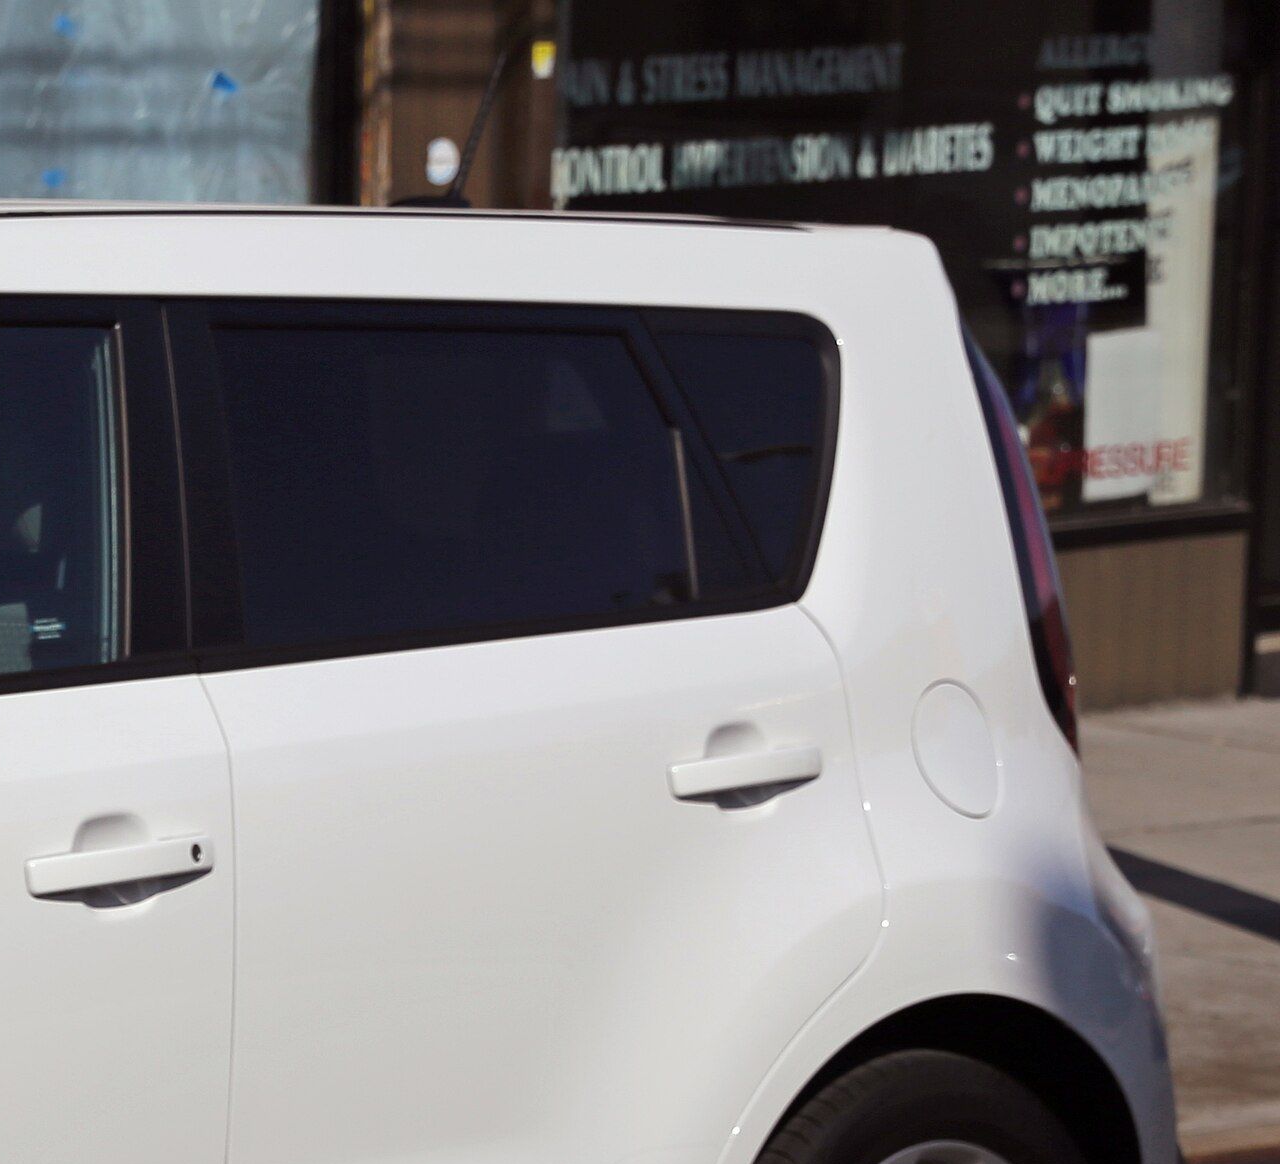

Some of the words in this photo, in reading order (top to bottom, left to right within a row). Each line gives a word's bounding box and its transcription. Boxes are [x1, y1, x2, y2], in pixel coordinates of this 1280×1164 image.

[561, 57, 611, 106] AIN
[641, 51, 729, 102] STRESS
[736, 43, 905, 97] MANAGEMENT
[1034, 83, 1103, 125] QUIT
[1106, 75, 1235, 114] SMOKING
[551, 143, 666, 199] CONTROL
[671, 132, 852, 191] HYPERTENSION
[883, 121, 995, 177] DIABETES
[1033, 125, 1142, 164] WEIGHT
